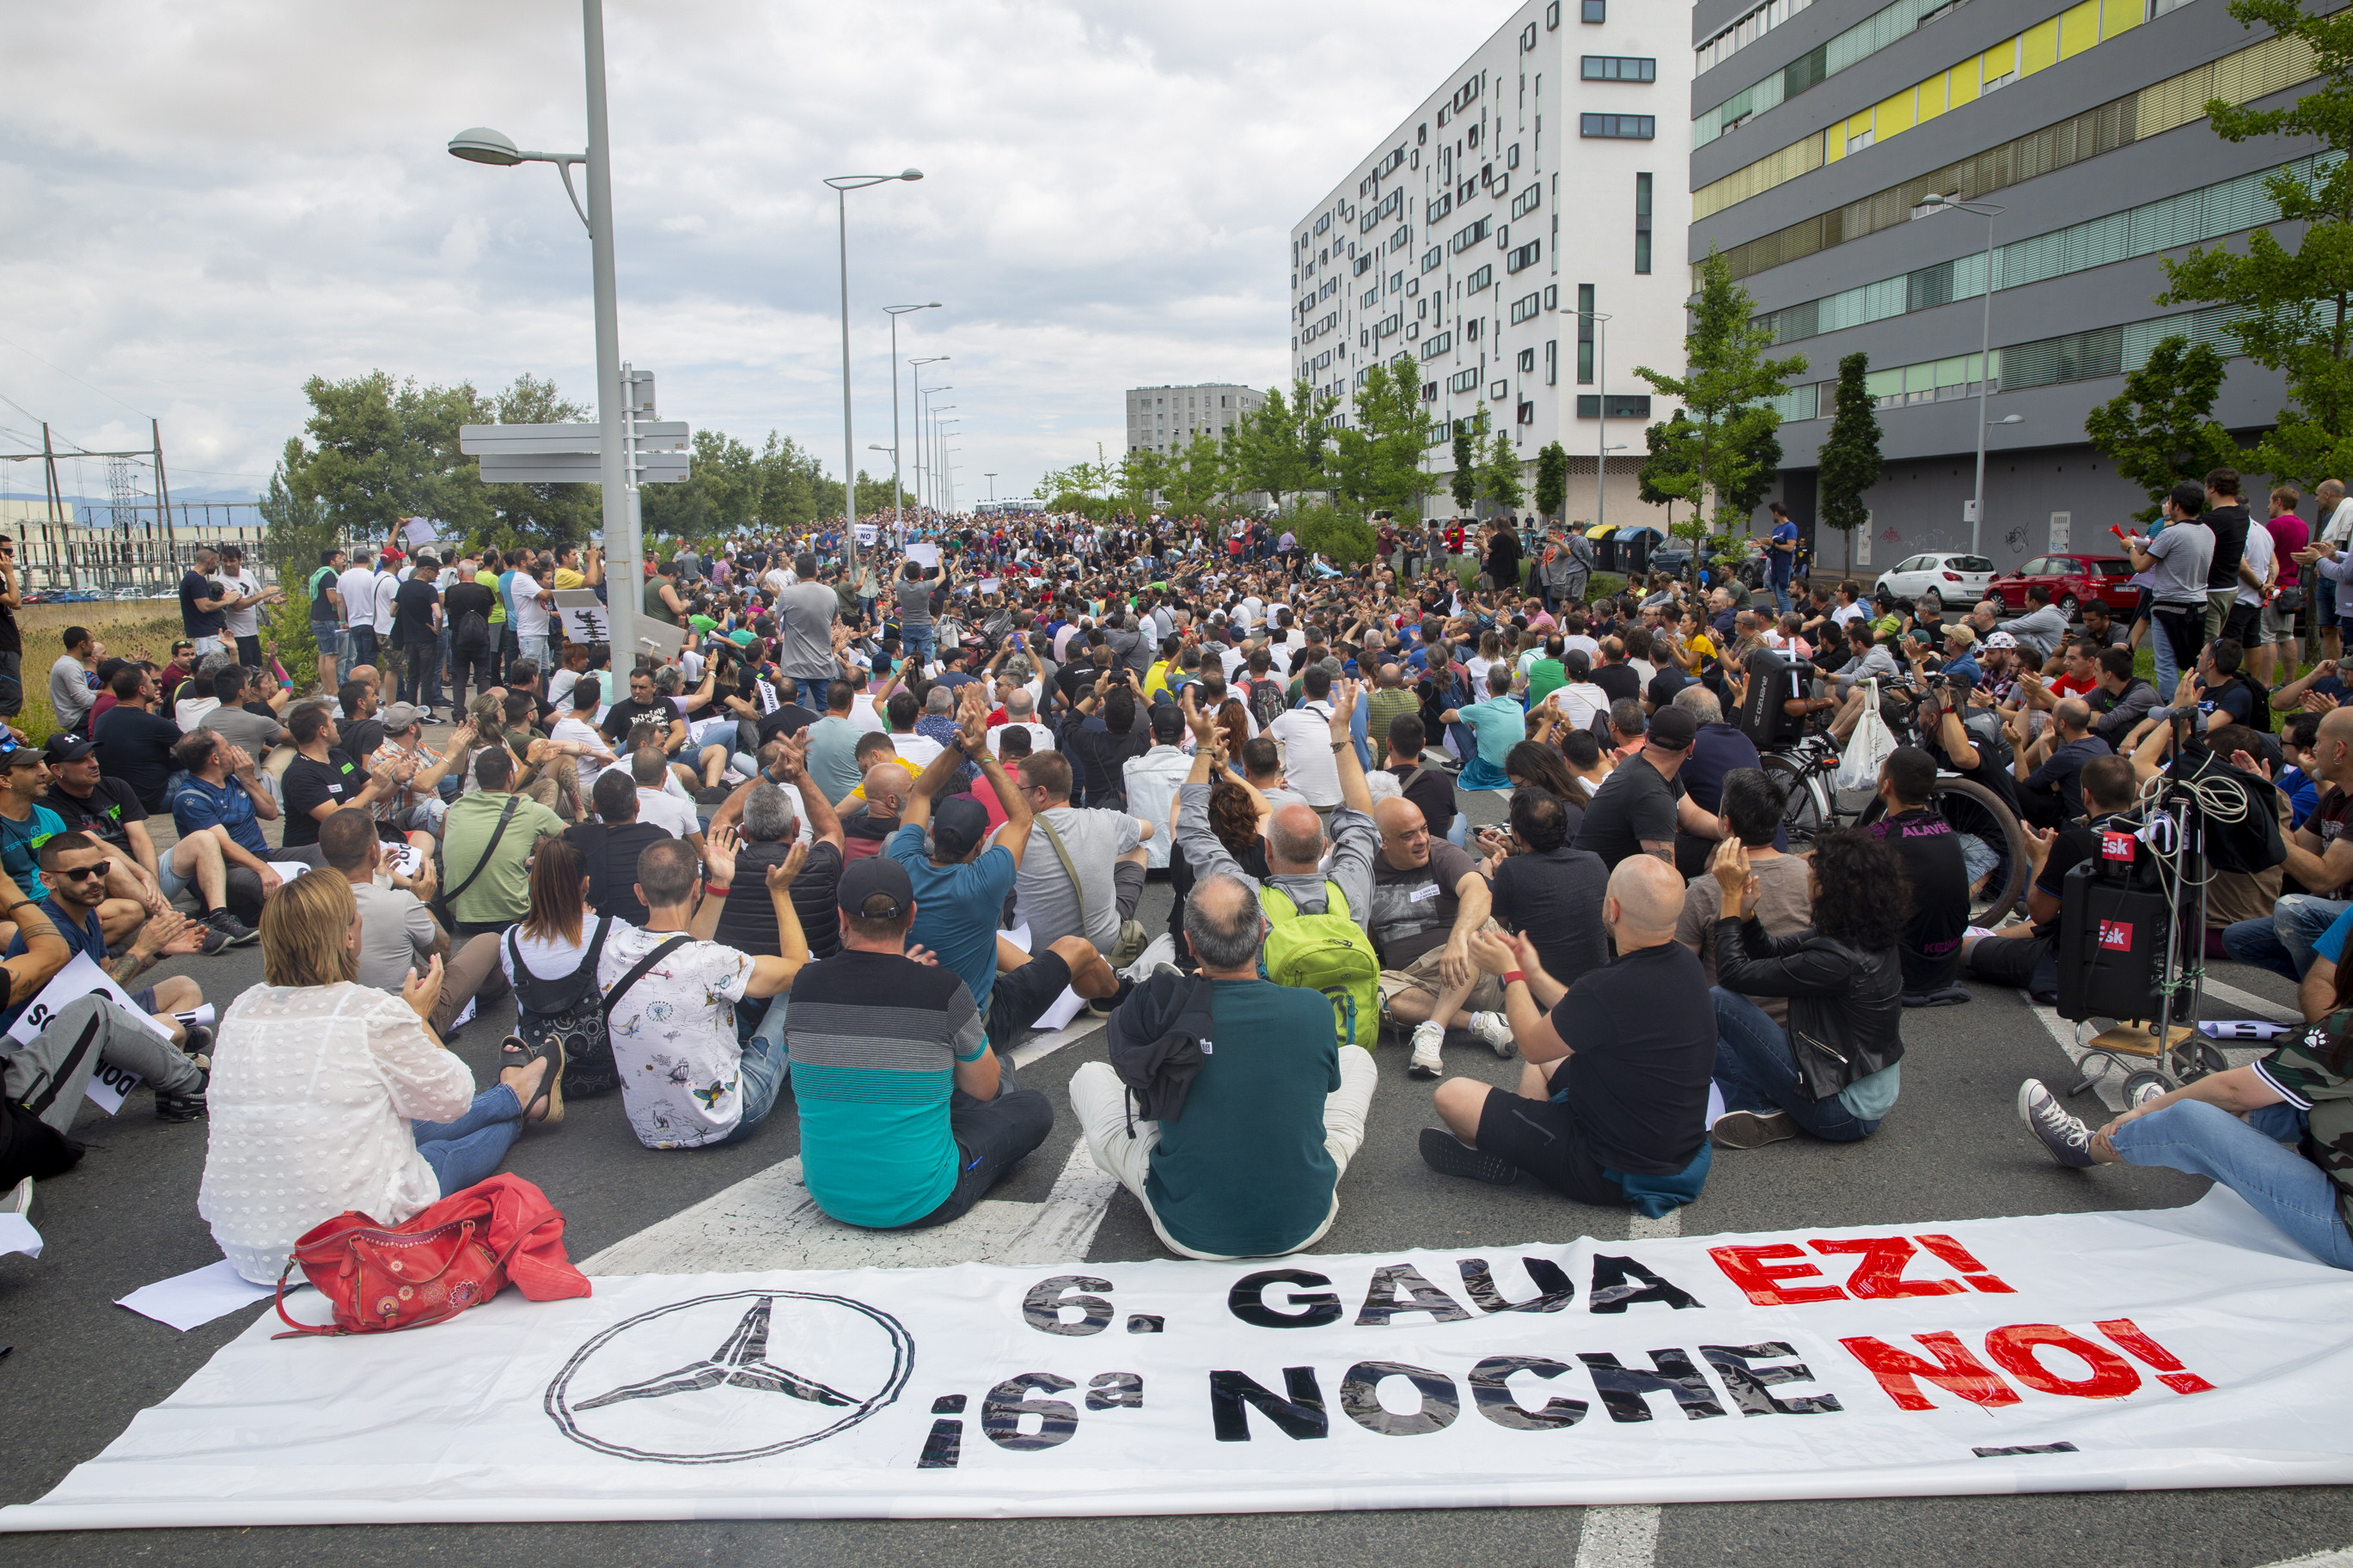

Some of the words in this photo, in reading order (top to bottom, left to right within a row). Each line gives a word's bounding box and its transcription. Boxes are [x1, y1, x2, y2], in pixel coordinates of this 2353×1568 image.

[1902, 820, 1953, 839] ALAVÉS
[1023, 1276, 1166, 1337] 6.
[1227, 1253, 1706, 1329] GAUA
[1707, 1234, 2017, 1307] EZ!
[1209, 1342, 1844, 1442] NOCHE
[1837, 1318, 2217, 1412] NO!
